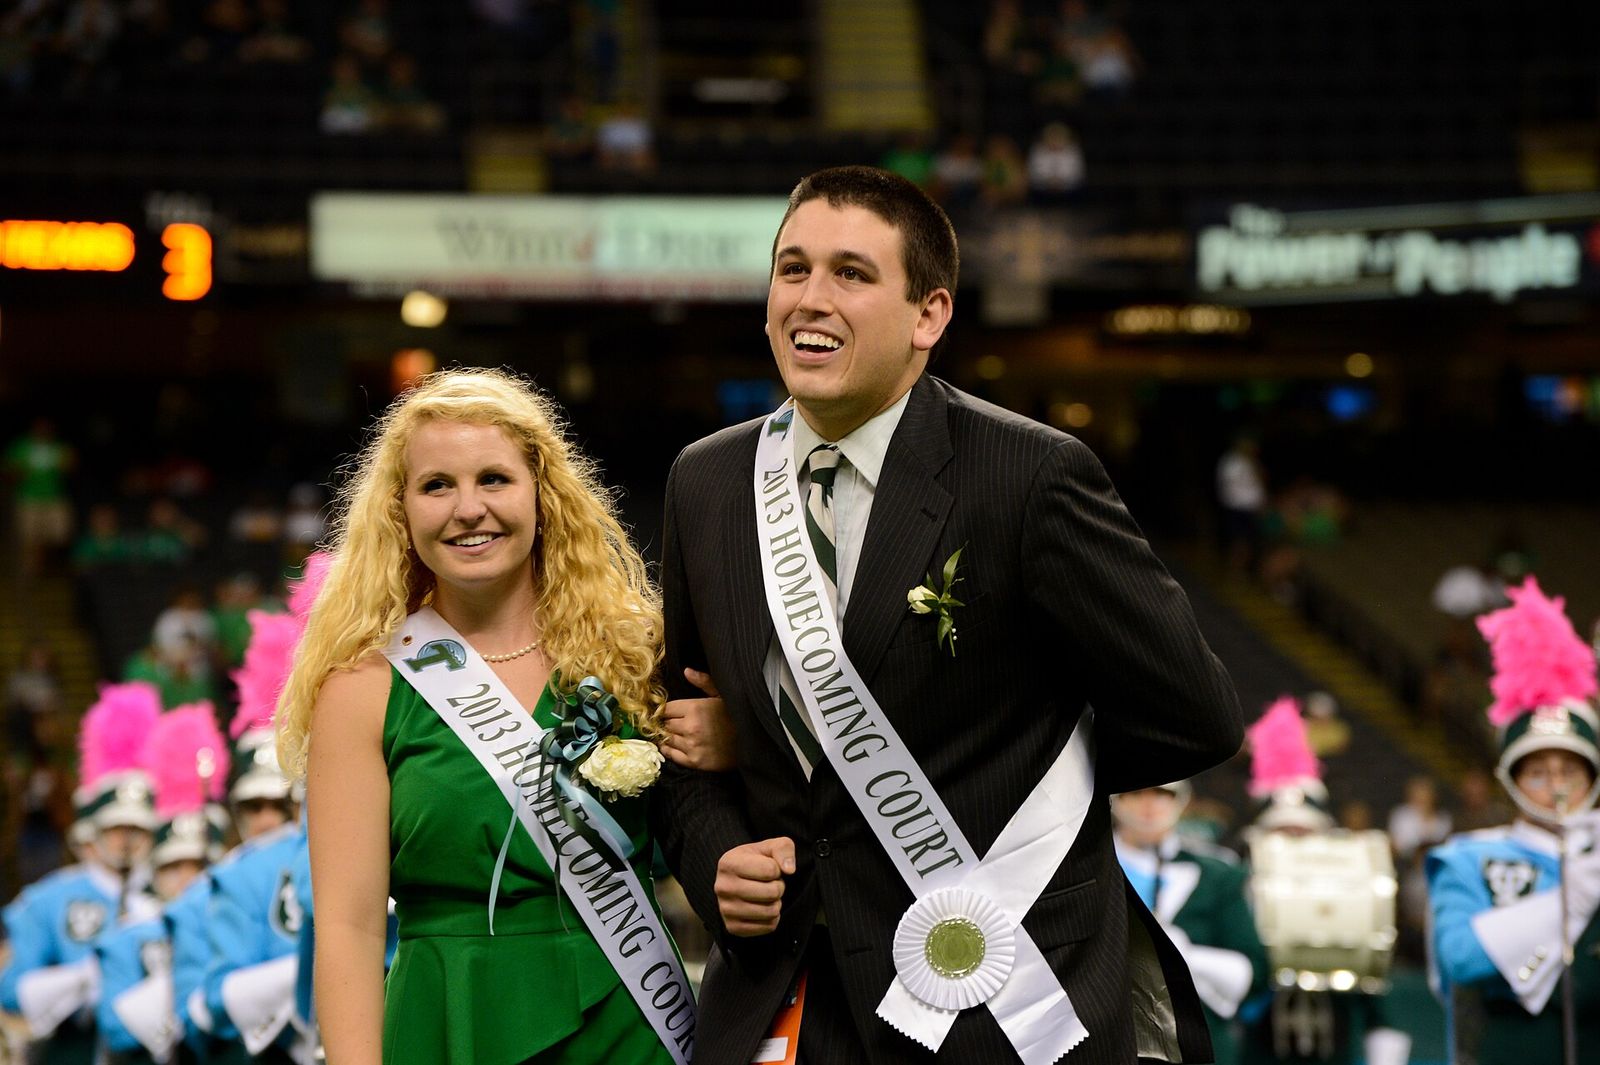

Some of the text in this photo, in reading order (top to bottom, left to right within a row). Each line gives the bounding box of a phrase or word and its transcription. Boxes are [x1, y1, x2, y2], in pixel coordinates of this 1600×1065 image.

[763, 458, 964, 880] 2013 HOMECOMING COURT
[447, 683, 522, 742] 2013
[640, 961, 697, 1062] COUR
